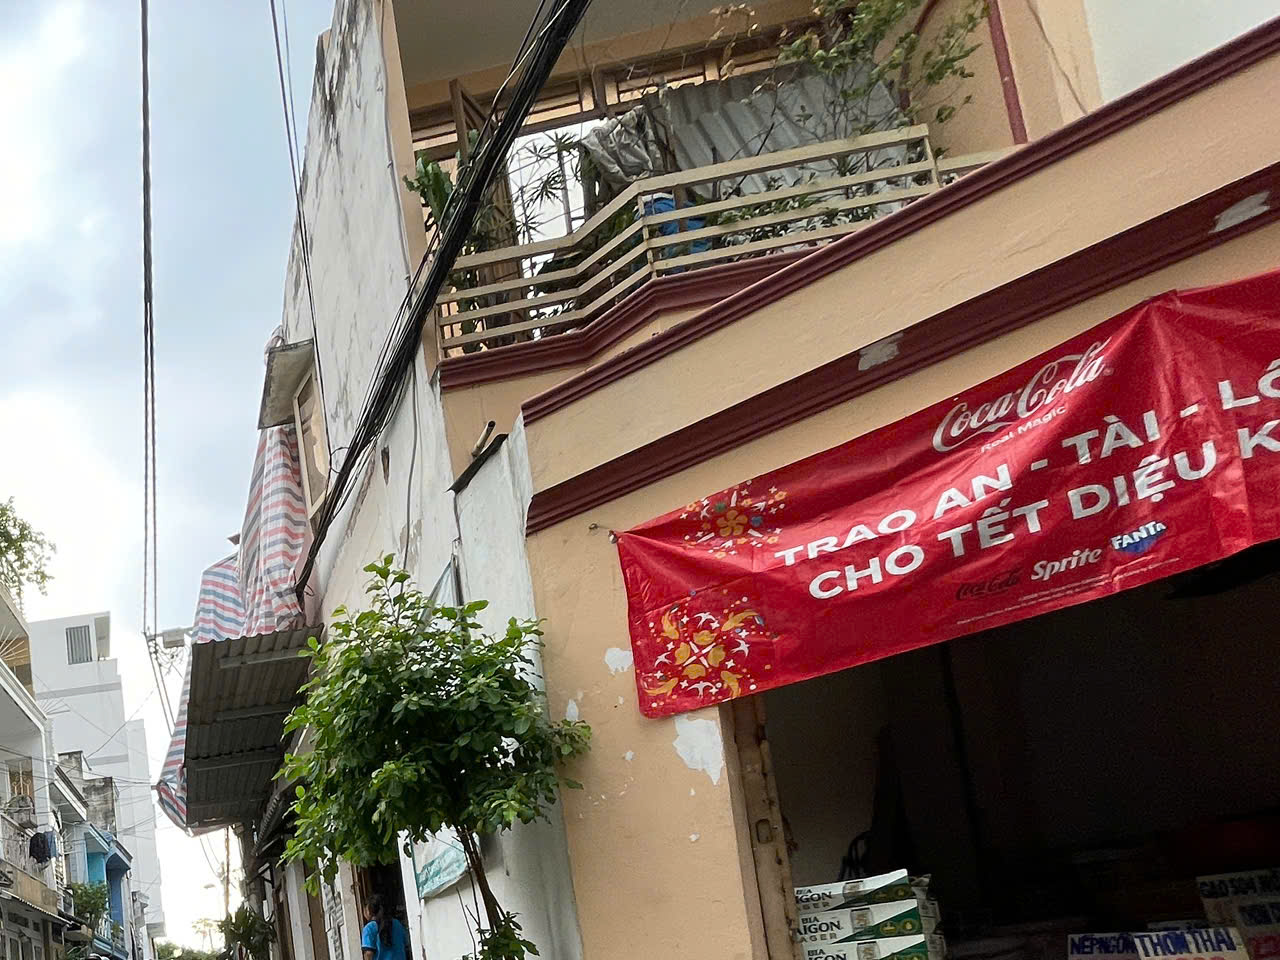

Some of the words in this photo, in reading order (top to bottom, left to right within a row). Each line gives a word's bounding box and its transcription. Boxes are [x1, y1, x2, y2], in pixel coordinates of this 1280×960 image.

[980, 431, 1014, 453] Real
[1017, 405, 1067, 435] Magic
[774, 509, 917, 567] TRAO
[933, 463, 1013, 520] AN
[1061, 409, 1161, 465] TÀI
[809, 544, 925, 600] CHO
[937, 497, 1049, 558] TẾT
[1067, 440, 1217, 520] DIỆU
[1030, 547, 1103, 582] Sprite
[801, 916, 820, 924] BIA
[807, 948, 826, 956] BIA
